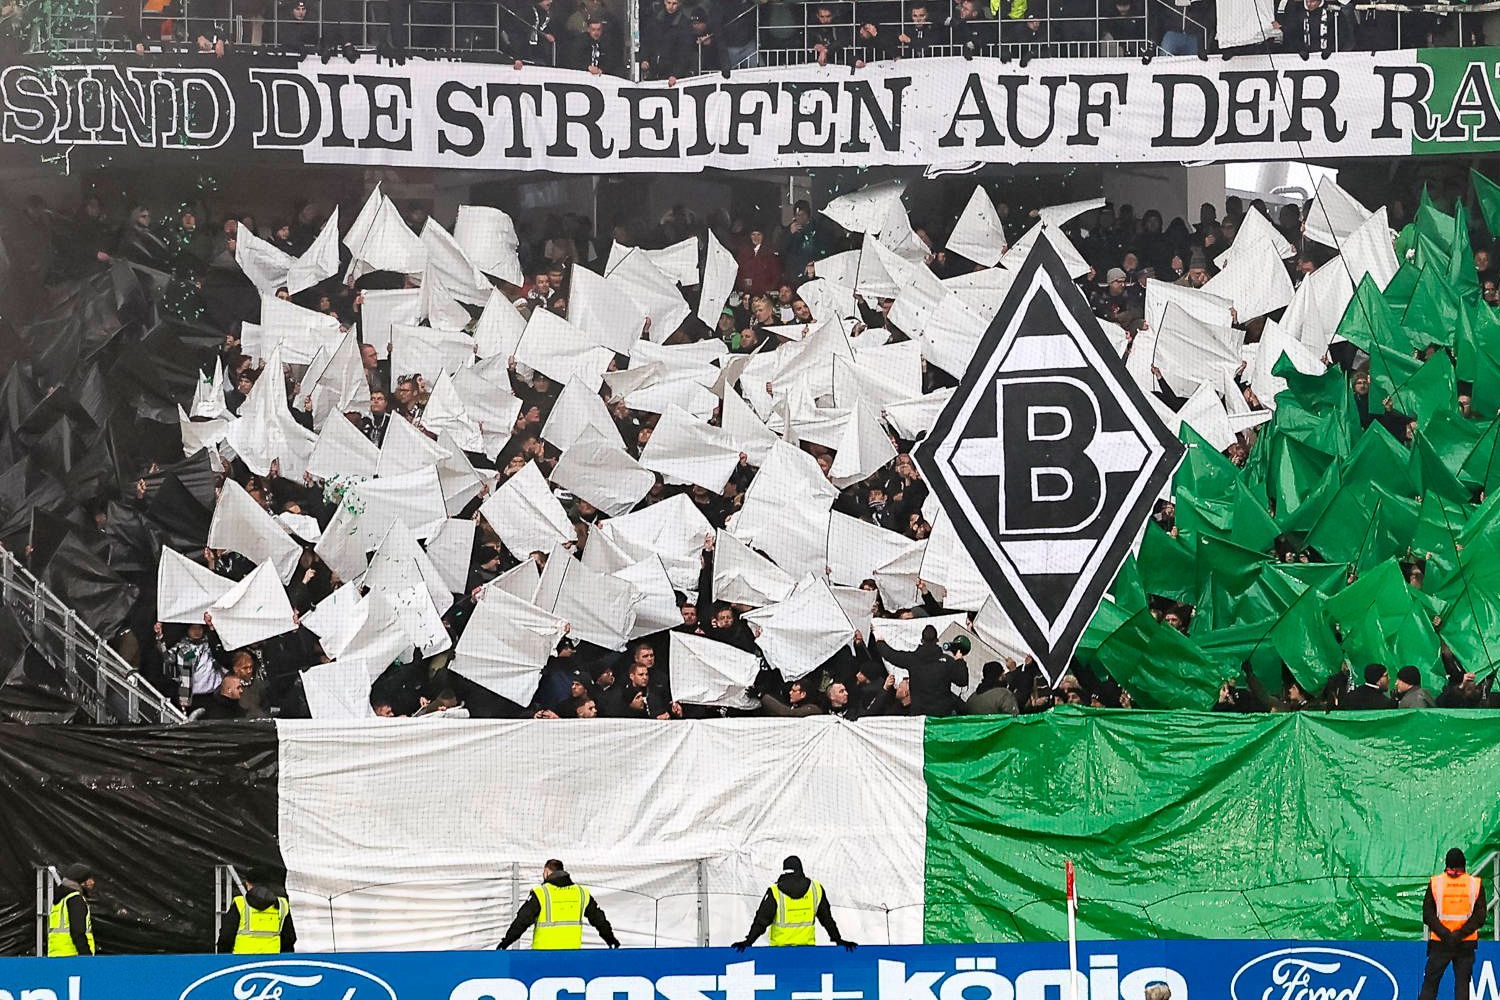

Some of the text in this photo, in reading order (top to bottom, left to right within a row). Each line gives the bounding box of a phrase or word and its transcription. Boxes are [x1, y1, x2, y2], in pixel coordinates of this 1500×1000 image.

[1, 64, 236, 148] SIND
[252, 68, 413, 151] DIE
[437, 76, 903, 157] STREIFEN
[938, 71, 1129, 148] AUF
[1150, 68, 1348, 147] DER
[996, 376, 1106, 535] B
